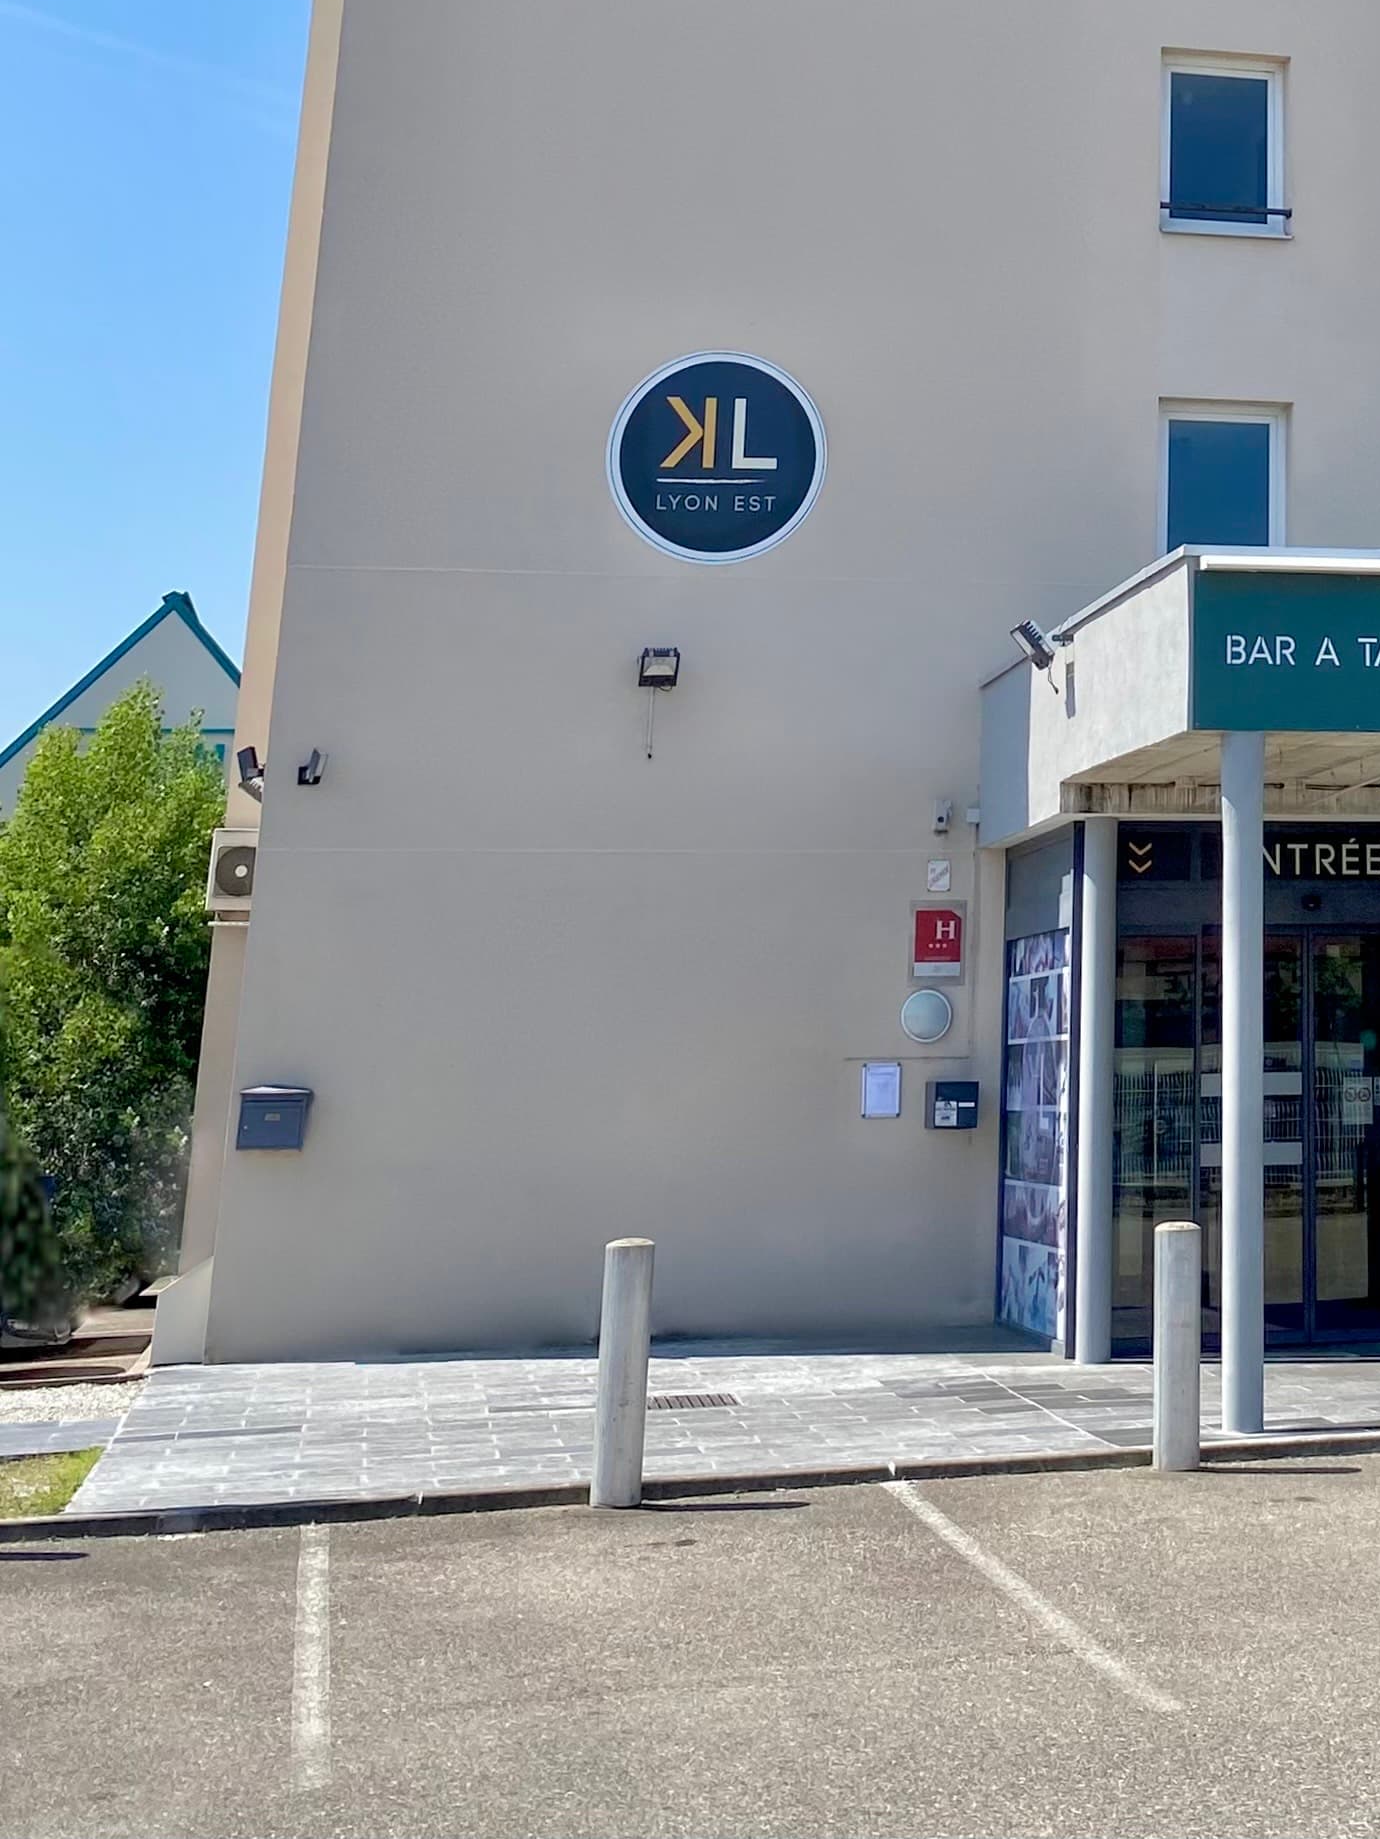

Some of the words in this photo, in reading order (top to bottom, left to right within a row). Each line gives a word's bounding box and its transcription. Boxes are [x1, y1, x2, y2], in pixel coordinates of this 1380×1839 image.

[660, 396, 778, 470] KL
[656, 494, 719, 511] LYON
[734, 495, 777, 512] EST
[1226, 635, 1296, 666] BAR
[1315, 637, 1341, 667] A
[935, 919, 956, 940] H
